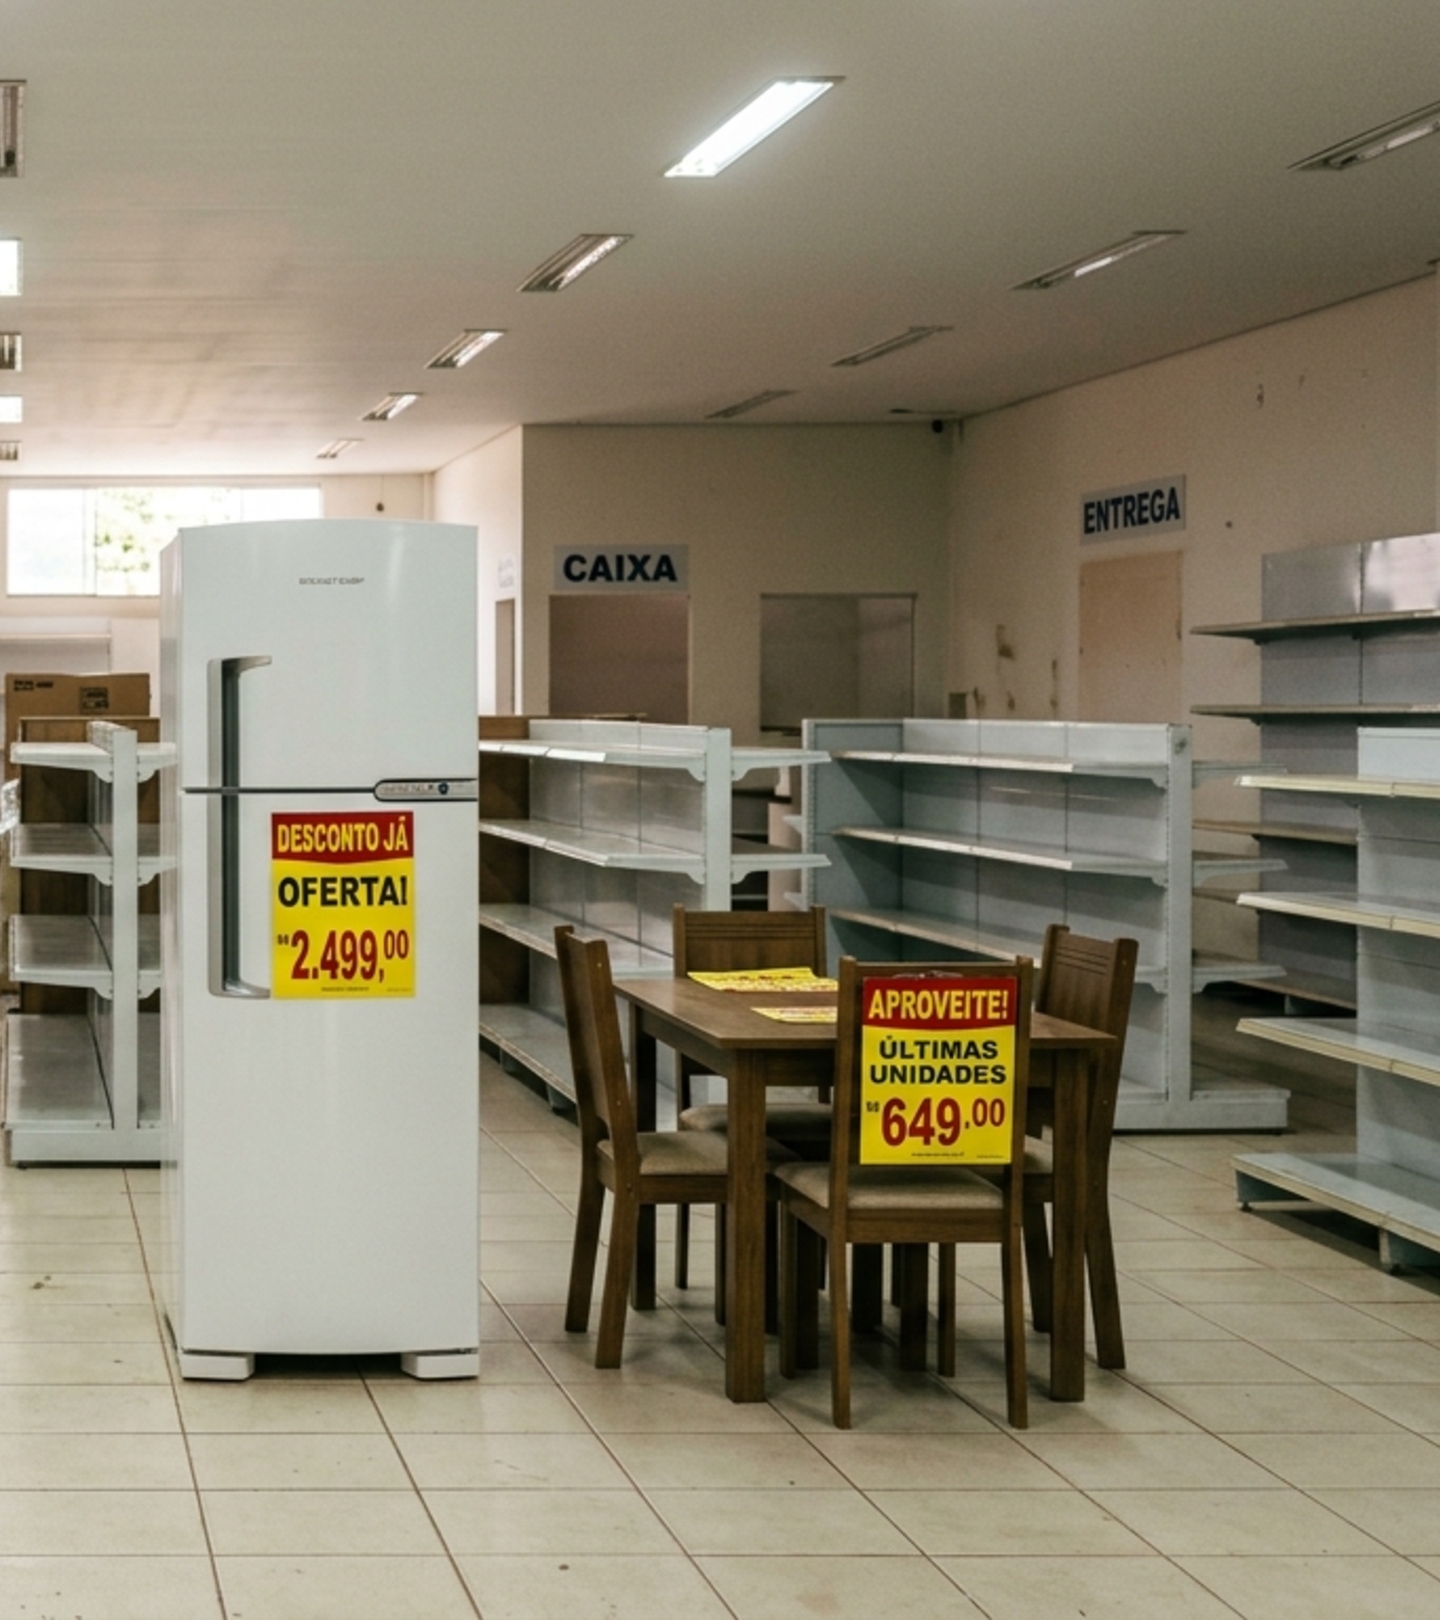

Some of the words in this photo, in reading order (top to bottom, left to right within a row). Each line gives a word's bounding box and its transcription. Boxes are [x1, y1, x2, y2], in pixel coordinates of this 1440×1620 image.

[1083, 487, 1180, 534] ENTREGA
[563, 554, 678, 582] CAIXA
[277, 822, 379, 853] DESCONTO
[383, 815, 409, 851] JÁ
[278, 876, 408, 907] OFERTA!
[290, 929, 409, 983] 2.499,00
[868, 989, 1009, 1020] APROVEITE!
[879, 1035, 998, 1059] ÚLTIMAS
[870, 1065, 1007, 1084] UNIDADES
